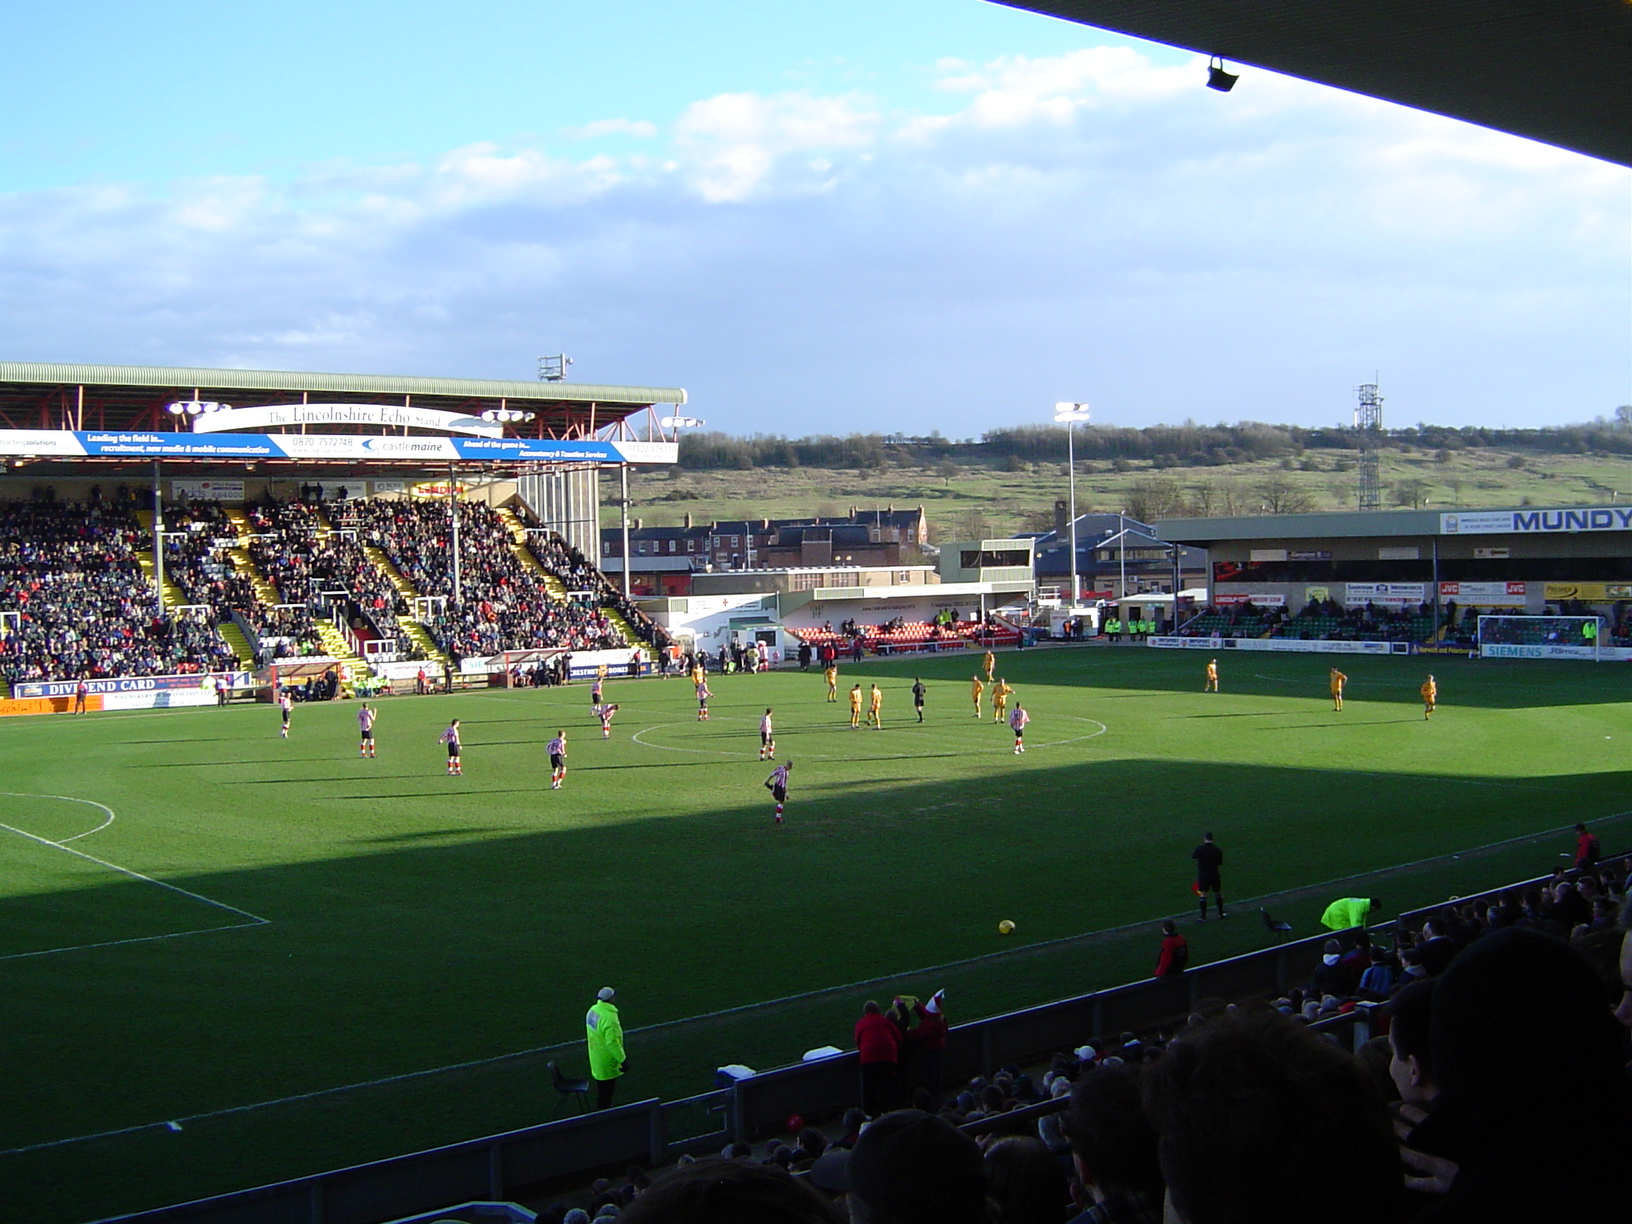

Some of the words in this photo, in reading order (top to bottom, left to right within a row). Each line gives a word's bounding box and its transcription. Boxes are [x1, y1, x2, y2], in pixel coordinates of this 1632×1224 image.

[268, 411, 287, 423] The
[294, 406, 374, 422] Lincolnshire
[380, 408, 410, 424] Echo
[415, 416, 441, 427] Stand
[87, 434, 118, 443] Leading
[119, 434, 131, 442] the
[132, 434, 149, 442] field
[292, 437, 314, 446] 0870
[383, 441, 443, 452] castlemaine
[483, 440, 491, 448] of
[192, 445, 216, 453] mobile
[519, 450, 555, 459] Accountancy
[585, 451, 607, 459] Services
[176, 486, 206, 498] Tdds
[1513, 509, 1632, 532] MUNDY
[1442, 584, 1458, 593] JVC
[1508, 584, 1524, 593] JVC
[1488, 646, 1542, 657] SIEMENS
[49, 680, 117, 695] DIVIEND
[120, 679, 155, 691] CARD
